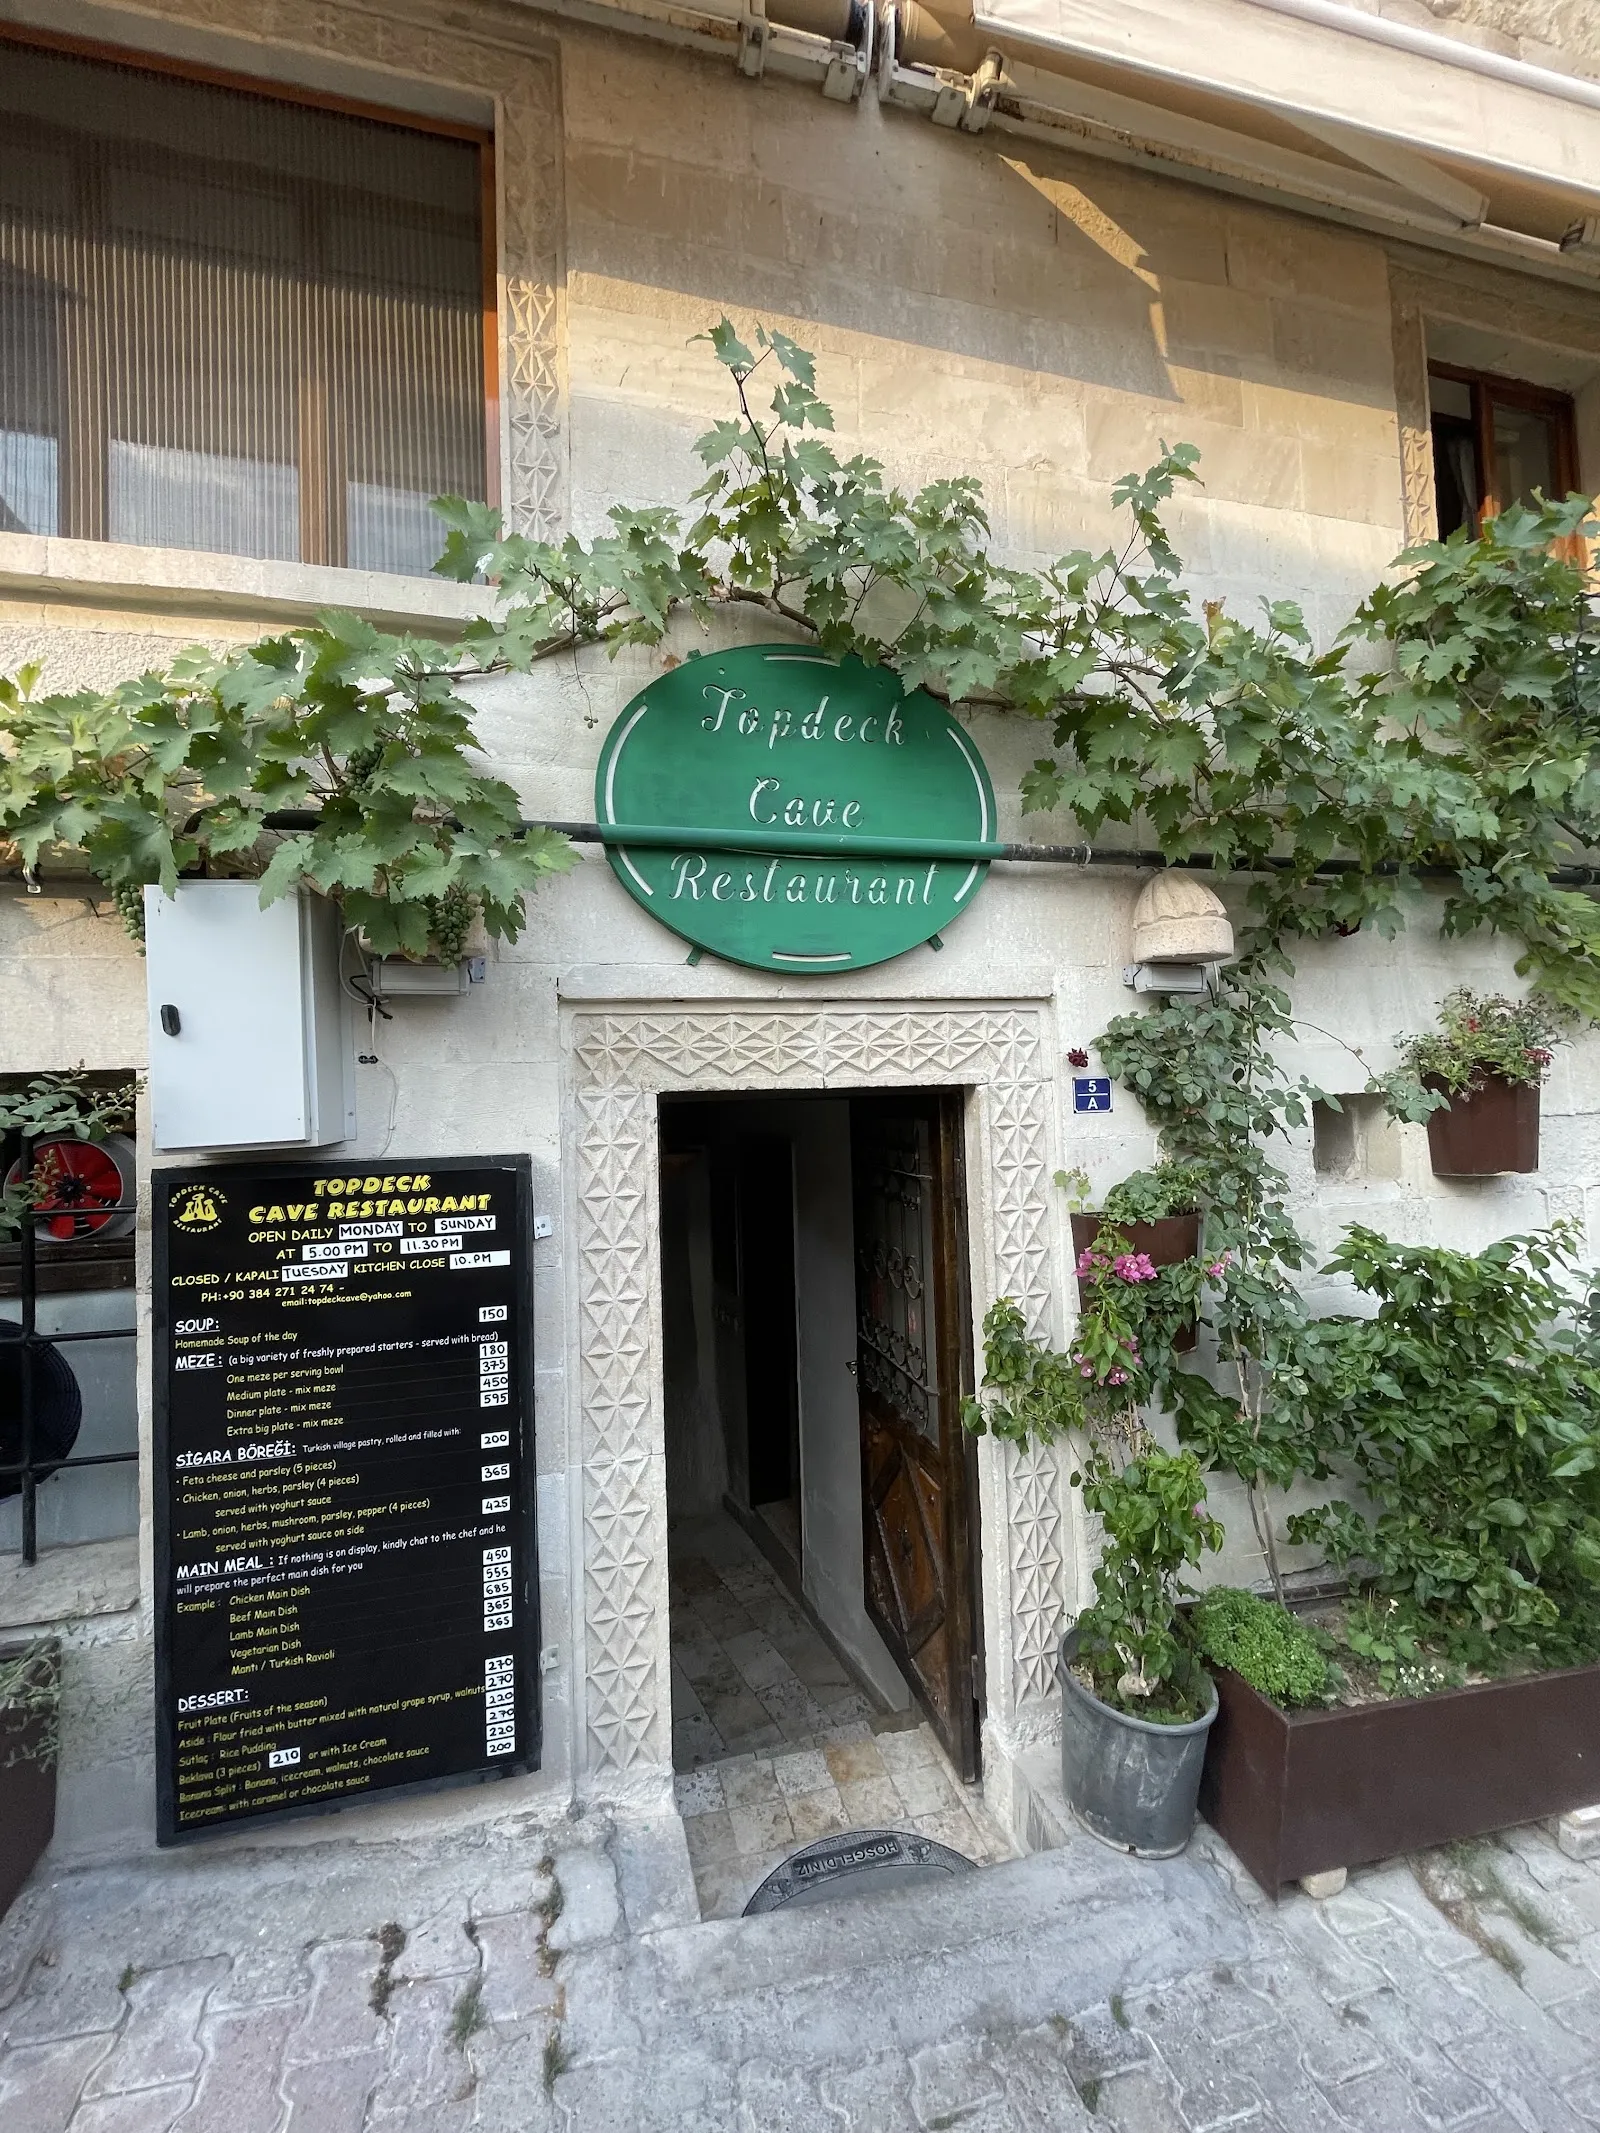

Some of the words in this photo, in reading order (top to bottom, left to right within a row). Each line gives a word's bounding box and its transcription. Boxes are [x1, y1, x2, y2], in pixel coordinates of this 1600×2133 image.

[701, 684, 905, 749] Topdeck
[748, 776, 864, 829] Cave
[669, 853, 938, 904] Restaurant
[1088, 1080, 1097, 1093] 5
[1087, 1097, 1098, 1110] A
[313, 1174, 431, 1197] TOPDECK
[169, 1185, 206, 1208] TOPDECK
[208, 1187, 228, 1204] CAVE
[248, 1203, 319, 1224] CAVE
[327, 1194, 492, 1219] RESTAURANT
[172, 1218, 222, 1233] RESTAURANT
[248, 1230, 286, 1244] OPEN
[291, 1228, 333, 1241] DAILY
[341, 1222, 400, 1237] MONDAY
[408, 1222, 427, 1233] TO
[440, 1217, 493, 1231] SUNDAY
[276, 1249, 296, 1260] AT
[309, 1246, 341, 1259] 5.00
[344, 1244, 364, 1255] PM
[373, 1242, 392, 1253] TO
[406, 1239, 439, 1252] 11.30
[442, 1238, 460, 1248] PM
[171, 1274, 220, 1287] CLOSED
[235, 1270, 280, 1283] KAPALI
[282, 1264, 346, 1279] TUESDAY
[353, 1261, 406, 1274] KITCHEN
[409, 1258, 446, 1270] CLOSE
[248, 1287, 271, 1300] 384
[274, 1287, 295, 1298] 271
[300, 1285, 316, 1296] 24
[320, 1283, 334, 1294] 74
[281, 1290, 412, 1307] email:topdeckcave@yahoo.com
[482, 1308, 504, 1320] 150
[175, 1318, 220, 1335] SOUP:
[175, 1336, 225, 1349] Homemade
[227, 1335, 249, 1345] Soup
[251, 1333, 261, 1343] of
[264, 1332, 280, 1341] the
[282, 1331, 298, 1342] day
[229, 1355, 238, 1366] (a
[240, 1354, 254, 1366] big
[256, 1352, 288, 1362] variety
[290, 1349, 300, 1359] of
[303, 1347, 335, 1358] freshly
[336, 1343, 375, 1357] prepared
[378, 1341, 413, 1352] starters
[422, 1336, 449, 1347] served
[451, 1334, 469, 1344] with
[472, 1331, 499, 1345] bread)
[481, 1345, 505, 1357] 180
[226, 1374, 245, 1384] One
[247, 1373, 271, 1382] meze
[273, 1372, 288, 1382] per
[290, 1367, 322, 1378] serving
[324, 1364, 343, 1375] bowl
[482, 1359, 506, 1372] 375
[483, 1377, 508, 1388] 450
[227, 1391, 261, 1401] Medium
[264, 1388, 286, 1400] plate
[295, 1385, 311, 1394] mix
[313, 1384, 336, 1393] meze
[484, 1393, 507, 1404] 595
[227, 1409, 257, 1419] Dinner
[259, 1406, 281, 1418] plate
[290, 1404, 306, 1412] mix
[308, 1402, 331, 1410] meze
[227, 1426, 253, 1437] Extra
[255, 1424, 269, 1435] big
[272, 1422, 294, 1434] plate
[303, 1420, 319, 1428] mix
[321, 1417, 344, 1426] meze
[484, 1434, 507, 1445] 200
[176, 1450, 232, 1468] SİGARA
[183, 1476, 204, 1485] Feta
[206, 1473, 238, 1483] cheese
[240, 1469, 256, 1479] and
[258, 1466, 291, 1479] parsley
[293, 1463, 303, 1475] (5
[305, 1459, 336, 1474] pieces)
[484, 1465, 508, 1478] 365
[183, 1492, 221, 1503] Chicken,
[223, 1489, 249, 1499] onion,
[252, 1484, 280, 1495] herbs,
[282, 1480, 315, 1494] parsley
[317, 1477, 326, 1489] (4
[328, 1473, 359, 1488] pieces)
[215, 1505, 246, 1518] served
[248, 1502, 268, 1513] with
[270, 1499, 305, 1513] yoghurt
[307, 1497, 331, 1506] sauce
[485, 1499, 508, 1511] 425
[176, 1561, 219, 1579] MAIN
[278, 1554, 288, 1565] If
[291, 1552, 324, 1563] nothing
[326, 1550, 333, 1558] is
[336, 1549, 346, 1557] on
[348, 1544, 380, 1556] display,
[383, 1538, 407, 1550] kindly
[410, 1536, 428, 1546] chat
[430, 1535, 440, 1543] to
[442, 1531, 456, 1541] the
[458, 1527, 477, 1539] chef
[479, 1525, 494, 1536] and
[496, 1524, 506, 1532] he
[486, 1549, 508, 1562] 450
[177, 1584, 192, 1595] will
[194, 1581, 230, 1595] prepare
[233, 1577, 248, 1587] the
[251, 1572, 285, 1587] perfect
[288, 1570, 308, 1579] main
[310, 1565, 329, 1577] dish
[331, 1563, 346, 1574] for
[347, 1563, 363, 1573] you
[486, 1566, 509, 1579] 555
[229, 1593, 264, 1605] Chicken
[267, 1590, 288, 1600] Main
[291, 1585, 310, 1597] Dish
[486, 1582, 509, 1595] 685
[230, 1610, 251, 1623] Beef
[254, 1610, 276, 1619] Main
[278, 1605, 298, 1616] Dish
[487, 1599, 510, 1612] 365
[487, 1616, 510, 1628] 365
[230, 1629, 254, 1641] Lamb
[256, 1627, 278, 1637] Main
[280, 1622, 300, 1633] Dish
[230, 1644, 279, 1659] Vegetarian
[282, 1639, 301, 1651] Dish
[488, 1658, 513, 1671] 270
[488, 1674, 513, 1687] 270
[178, 1689, 249, 1712] DESSERT:
[488, 1692, 514, 1704] 220
[178, 1719, 202, 1731] Fruit
[204, 1716, 227, 1726] Plate
[230, 1710, 262, 1723] (Fruits
[264, 1705, 274, 1716] of
[277, 1704, 292, 1713] the
[294, 1696, 327, 1711] season)
[489, 1708, 514, 1720] 270
[489, 1725, 514, 1737] 220
[489, 1742, 511, 1753] 200
[273, 1751, 299, 1764] 210
